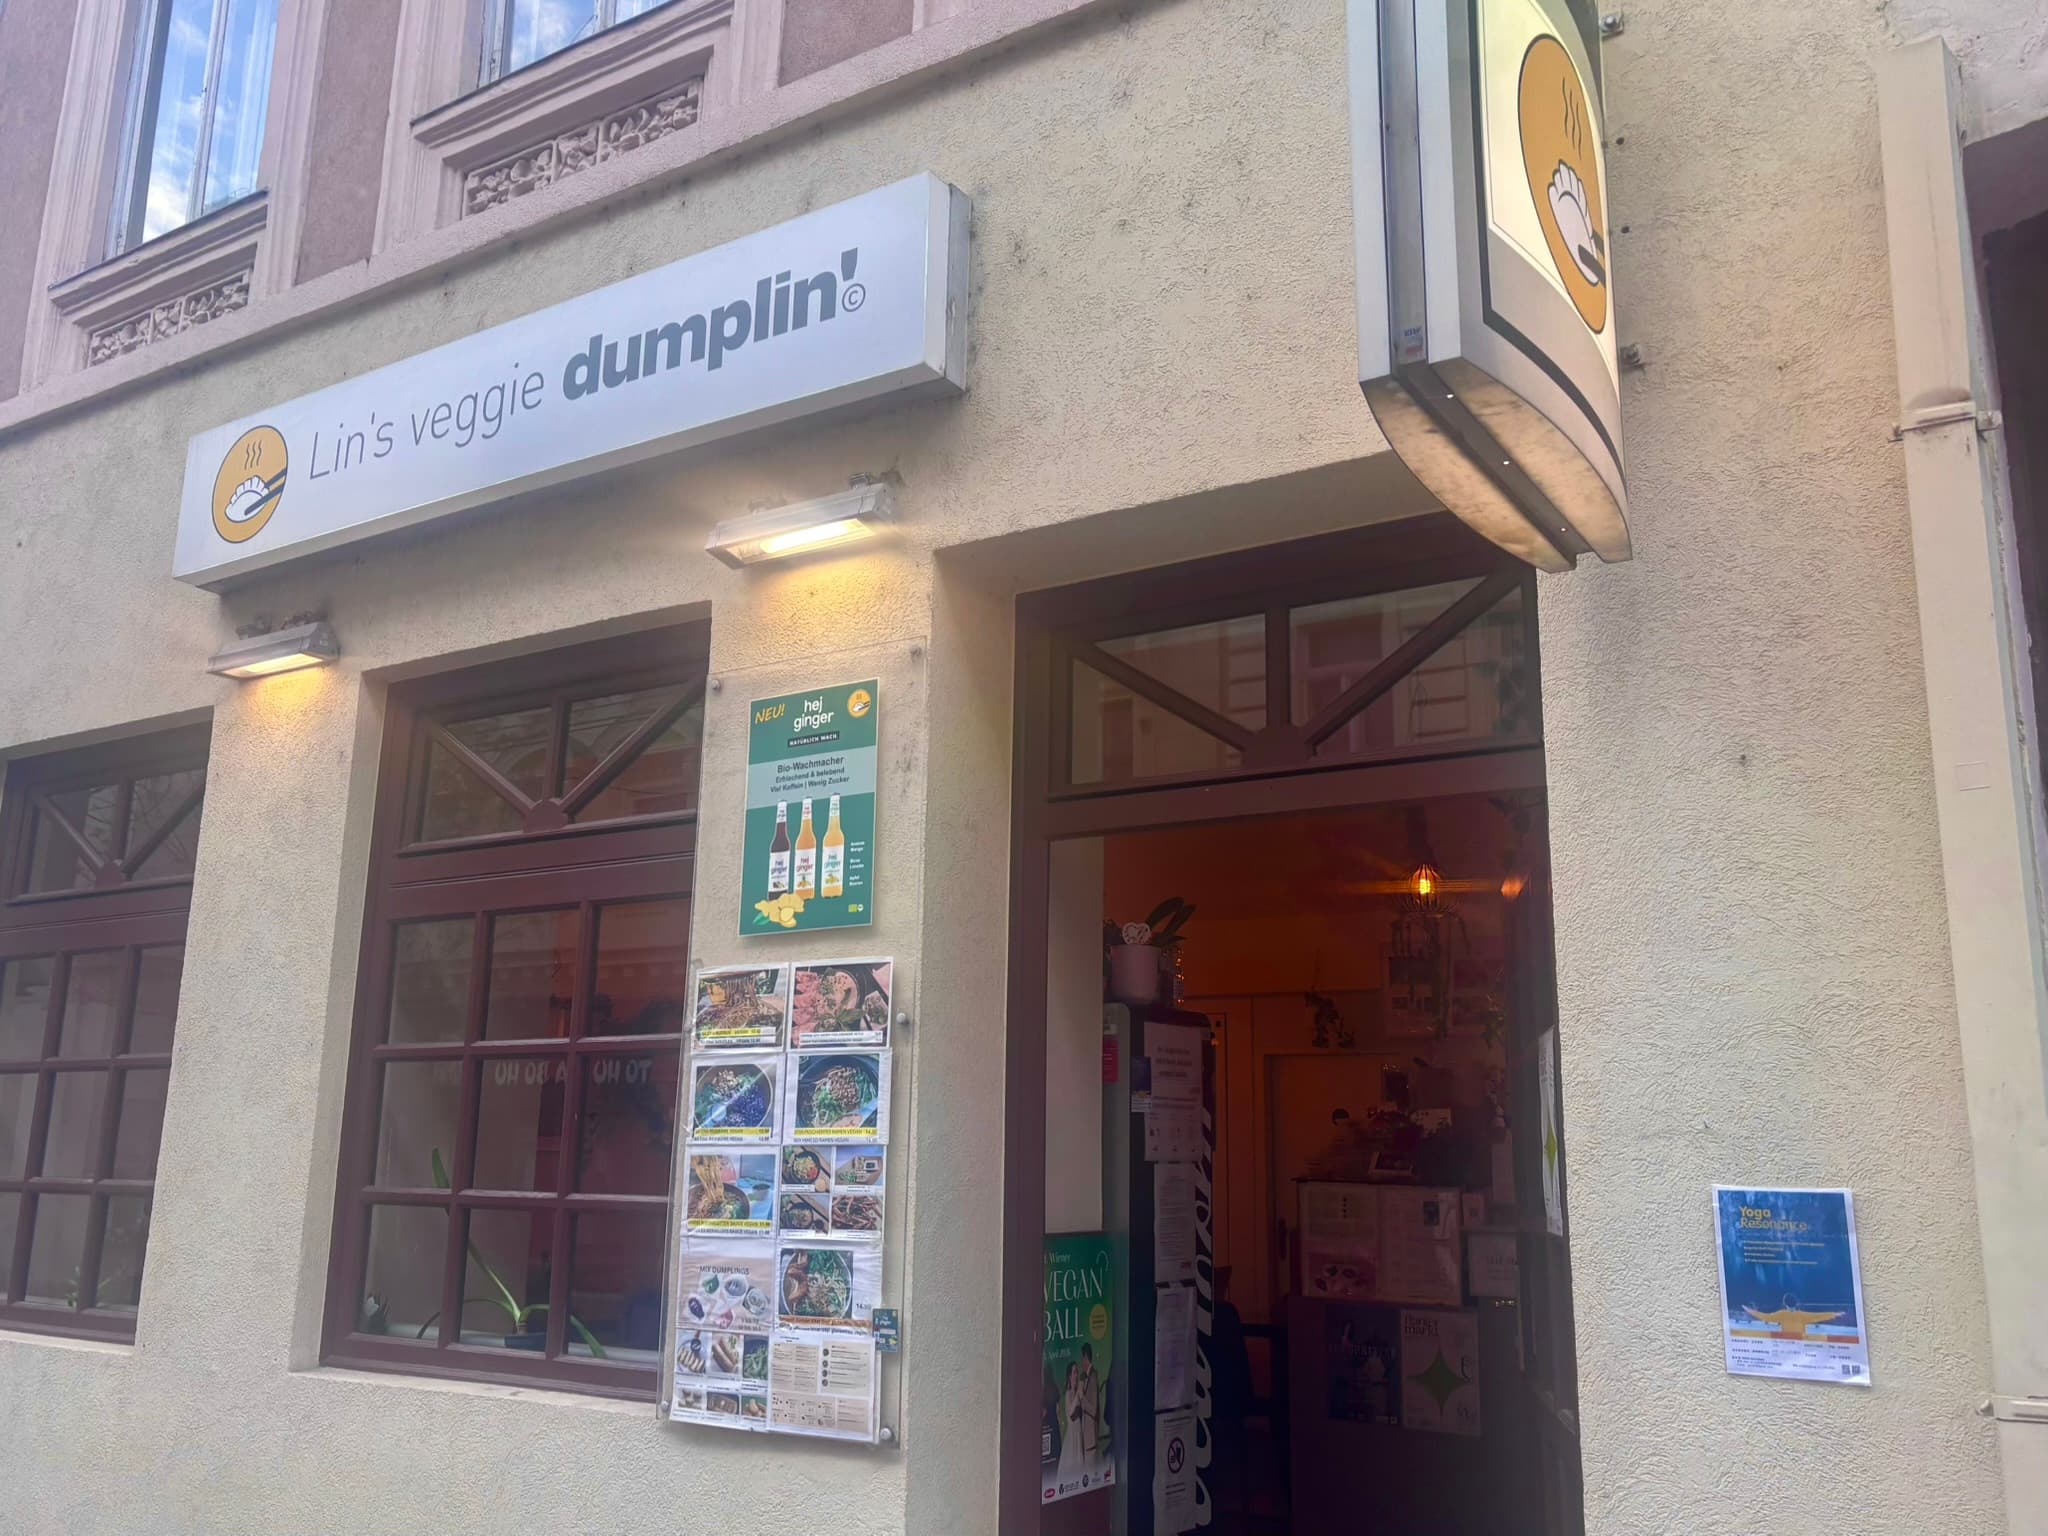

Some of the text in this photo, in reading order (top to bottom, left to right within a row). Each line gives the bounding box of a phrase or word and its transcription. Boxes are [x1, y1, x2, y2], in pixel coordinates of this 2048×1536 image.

[309, 413, 394, 480] Lin's
[411, 363, 545, 448] veggie
[804, 696, 823, 713] hej
[755, 704, 785, 724] NEU!
[793, 711, 835, 732] ginger
[777, 757, 844, 773] Bio-Wachmacher
[1740, 1206, 1771, 1219] Yoga
[1740, 1218, 1808, 1231] Resonance
[712, 1266, 749, 1275] DUMPLINGS
[1043, 1267, 1103, 1304] VEGAN
[1043, 1306, 1084, 1343] BALL
